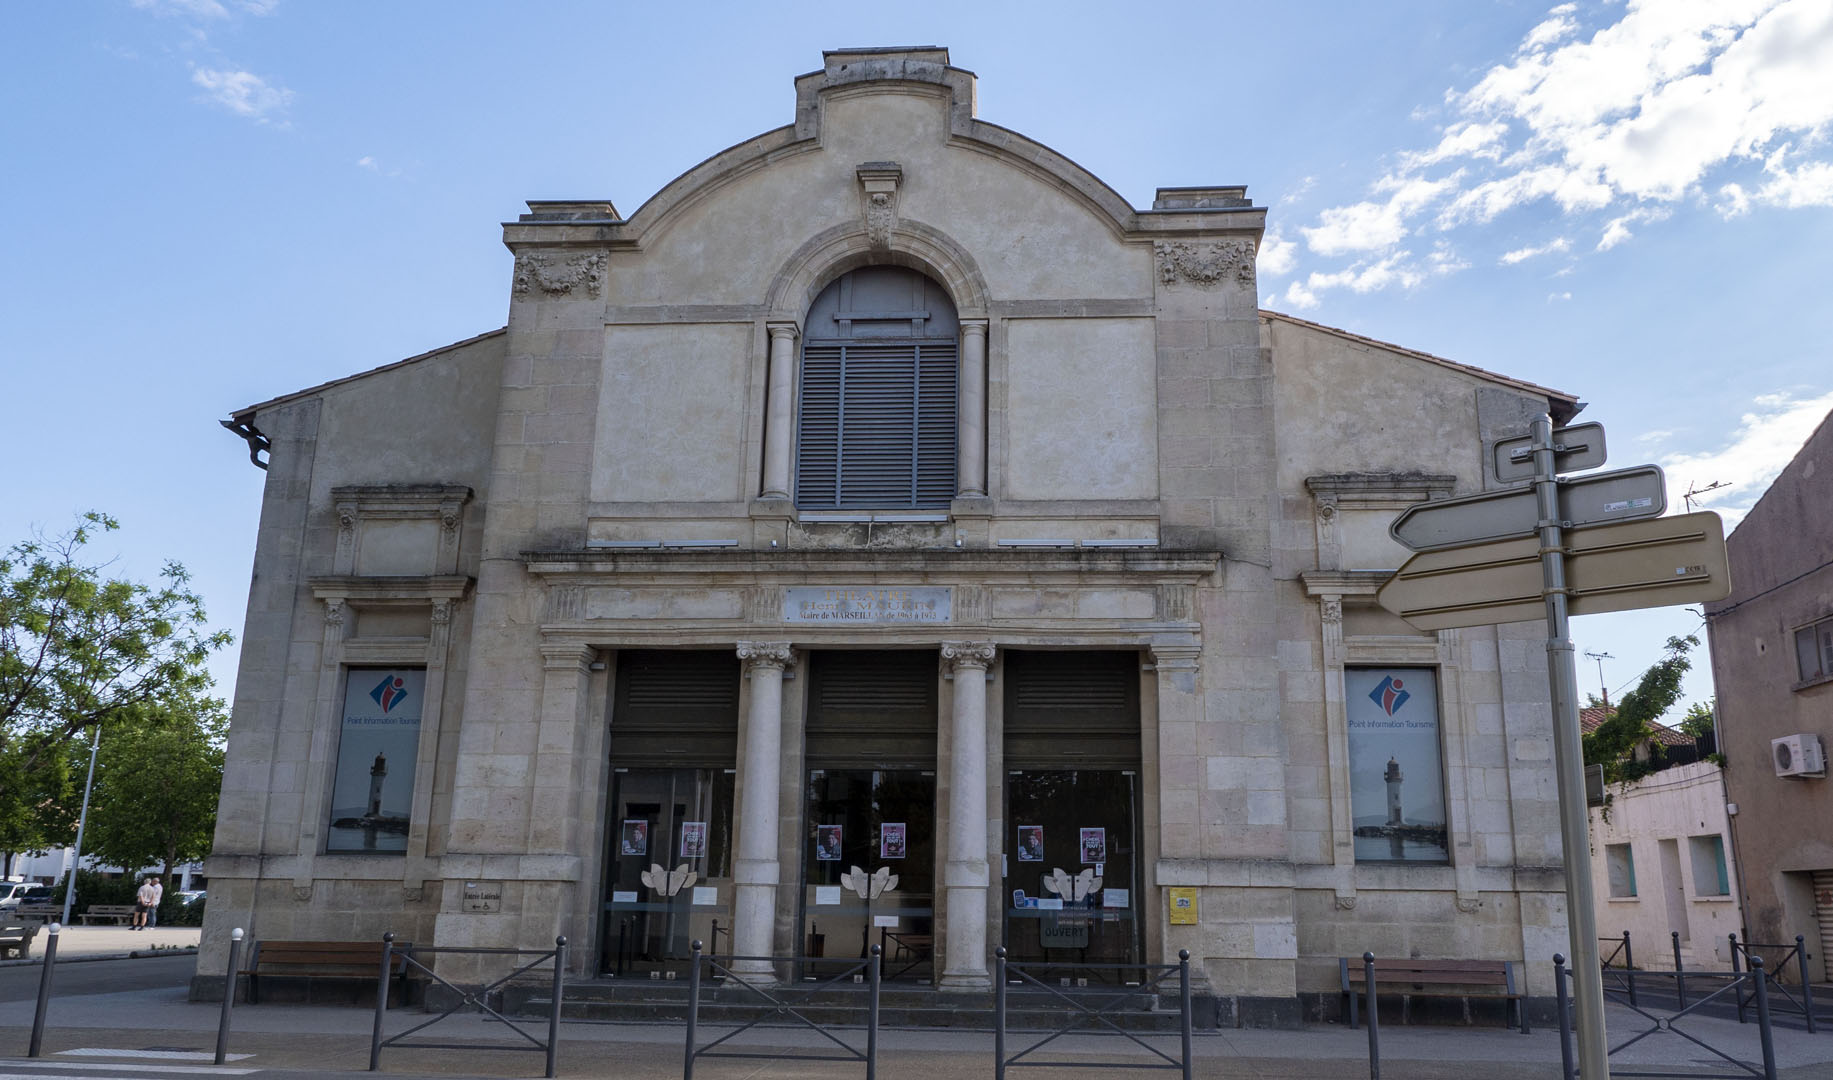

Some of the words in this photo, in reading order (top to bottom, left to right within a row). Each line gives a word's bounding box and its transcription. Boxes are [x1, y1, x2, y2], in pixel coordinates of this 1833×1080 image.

[821, 611, 830, 619] de
[347, 717, 362, 725] Point
[364, 717, 397, 725] Information
[399, 717, 421, 725] Tourism
[1349, 720, 1366, 728] Point
[1367, 720, 1404, 728] Information
[1405, 720, 1434, 728] Tourisme
[1045, 928, 1085, 937] OUVERT
